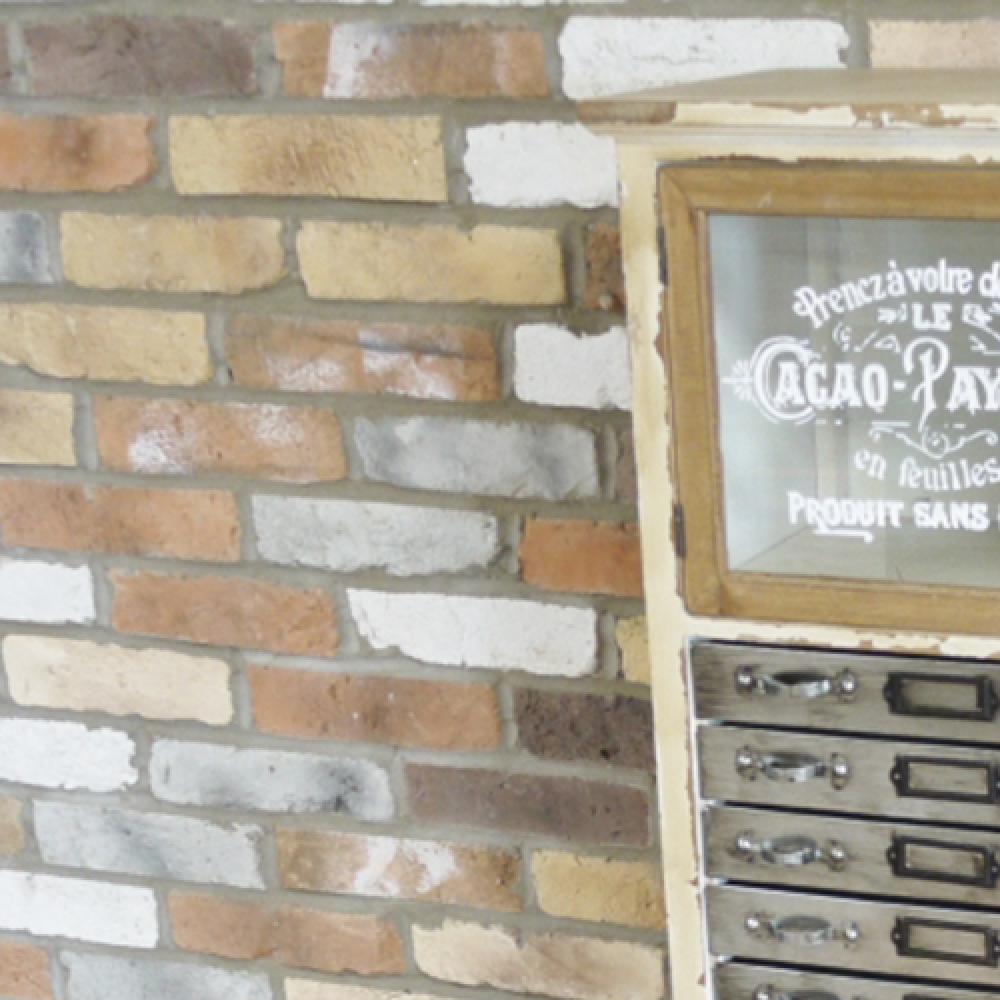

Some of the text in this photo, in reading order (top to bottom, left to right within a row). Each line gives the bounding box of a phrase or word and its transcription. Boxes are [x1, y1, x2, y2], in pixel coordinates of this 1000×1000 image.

[905, 257, 973, 294] votre
[912, 302, 952, 330] LE
[855, 450, 886, 480] en
[787, 491, 904, 543] PRODUIT
[914, 501, 989, 531] SANS
